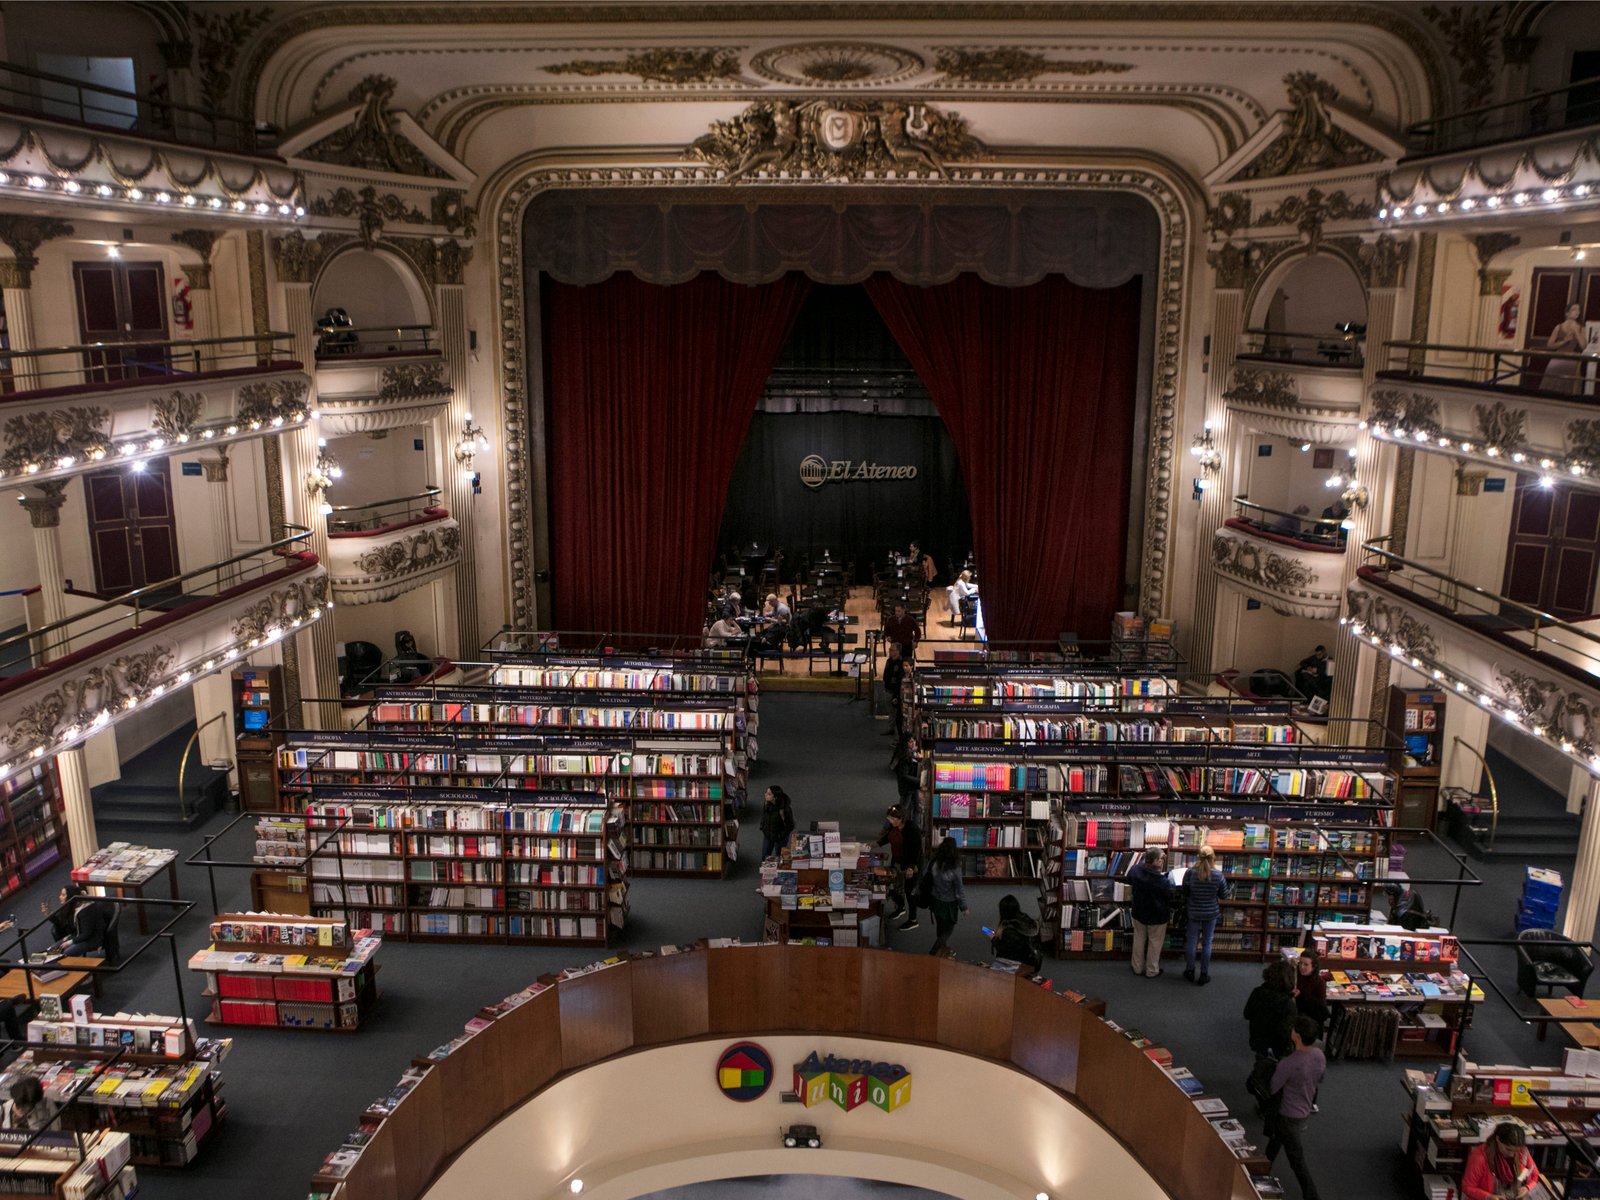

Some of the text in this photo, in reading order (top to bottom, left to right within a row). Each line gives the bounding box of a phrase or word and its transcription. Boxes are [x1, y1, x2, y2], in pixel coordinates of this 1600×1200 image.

[827, 460, 918, 480] El Ateneo
[797, 1051, 906, 1079] Ateneo
[795, 1076, 909, 1105] Junior
